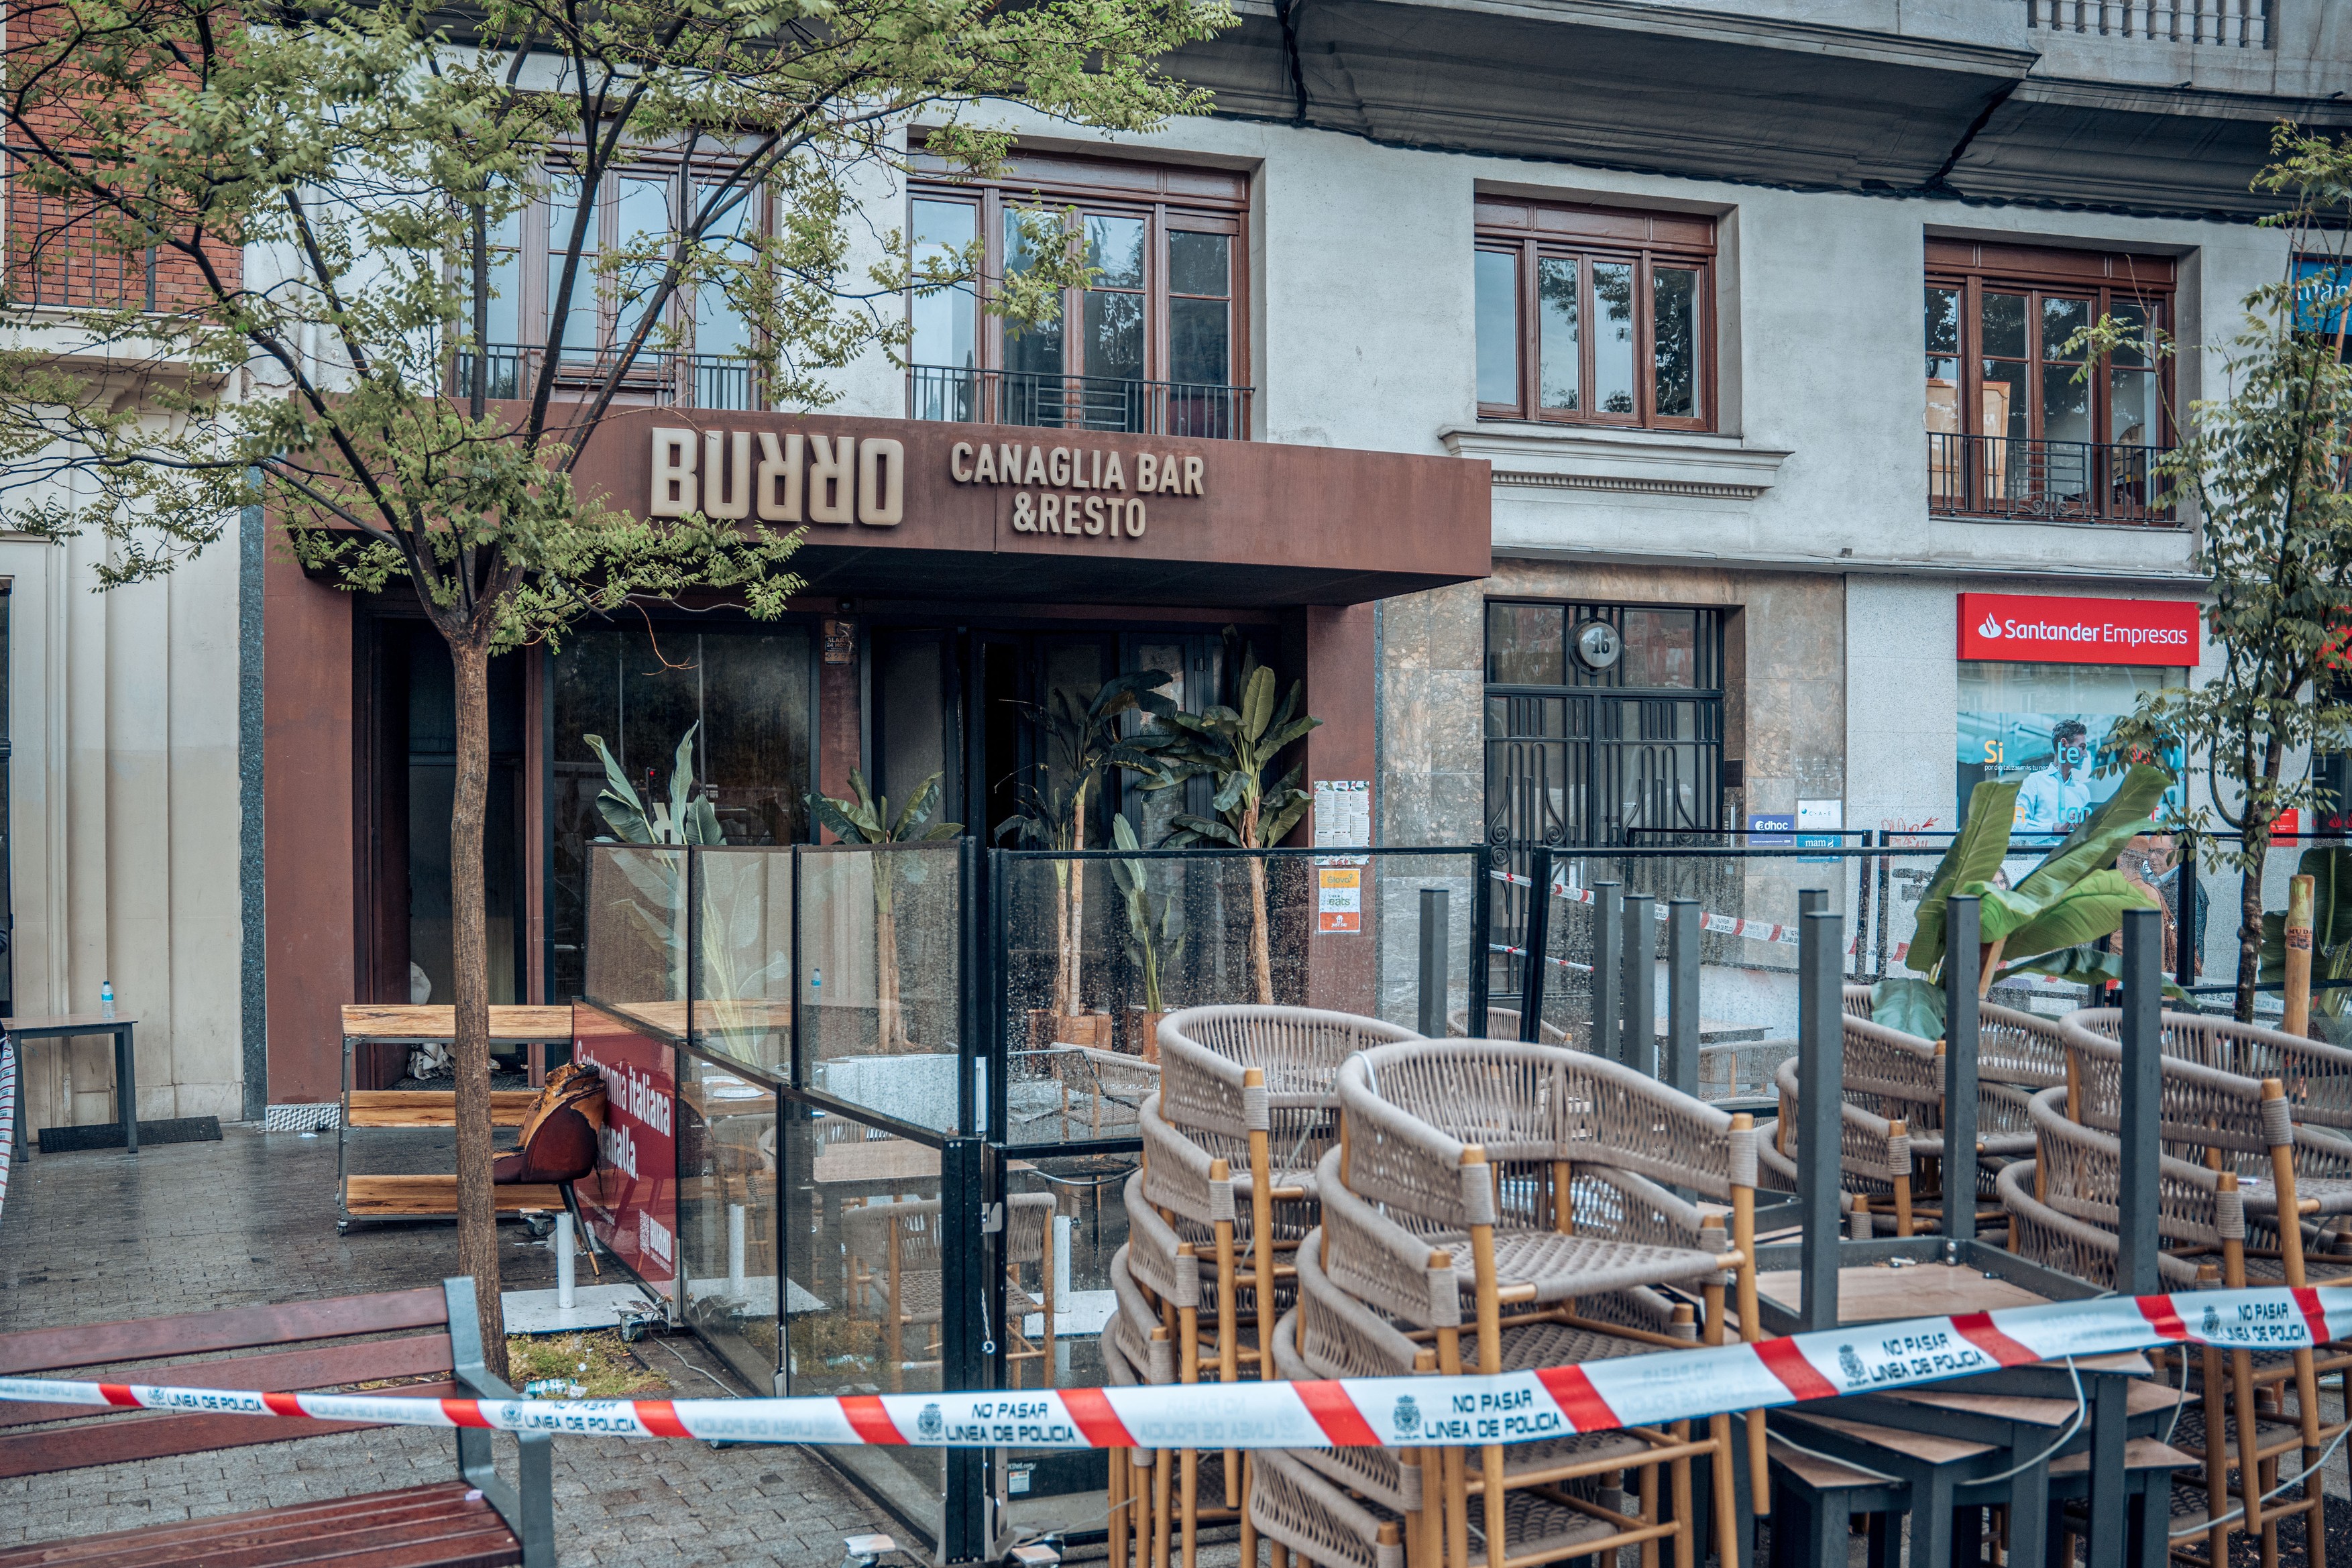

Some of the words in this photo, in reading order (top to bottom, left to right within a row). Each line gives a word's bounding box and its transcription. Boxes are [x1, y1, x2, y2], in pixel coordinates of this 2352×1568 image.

[951, 441, 1126, 490] CANAGLIA
[1136, 453, 1205, 496] BAR
[1013, 491, 1147, 538] &RESTO
[1592, 632, 1610, 655] 16
[2005, 619, 2100, 642] Santander
[2103, 623, 2188, 647] Empresas
[1984, 740, 2003, 763] Si
[2058, 742, 2079, 764] te
[1327, 875, 1351, 884] Glovo
[1329, 897, 1350, 905] eats
[629, 1066, 670, 1137] italiana
[2238, 1304, 2253, 1321] NO
[2255, 1303, 2289, 1320] PASAR
[2221, 1327, 2251, 1341] LINEA
[2253, 1327, 2269, 1341] DE
[2270, 1324, 2306, 1341] POLICIA
[1882, 1339, 1903, 1357] NO
[1904, 1333, 1951, 1353] PASAR
[1868, 1363, 1911, 1382] LINEA
[1911, 1358, 1932, 1375] DE
[1936, 1350, 1985, 1372] POLICIA
[166, 1393, 199, 1408] LINEA
[201, 1395, 217, 1410] DE
[220, 1396, 263, 1412] POLICIA
[972, 1403, 993, 1419] NO
[997, 1402, 1048, 1419] PASAR
[1453, 1395, 1475, 1412] NO
[1481, 1389, 1533, 1409] PASAR
[524, 1414, 562, 1430] LINEA
[565, 1416, 585, 1431] DE
[587, 1417, 638, 1433] POLICIA
[946, 1425, 987, 1442] LINEA
[993, 1425, 1013, 1442] DE
[1018, 1425, 1076, 1442] POLICIA
[1424, 1420, 1471, 1439] LINEA
[1477, 1418, 1500, 1437] DE
[1505, 1412, 1561, 1435] POLICIA
